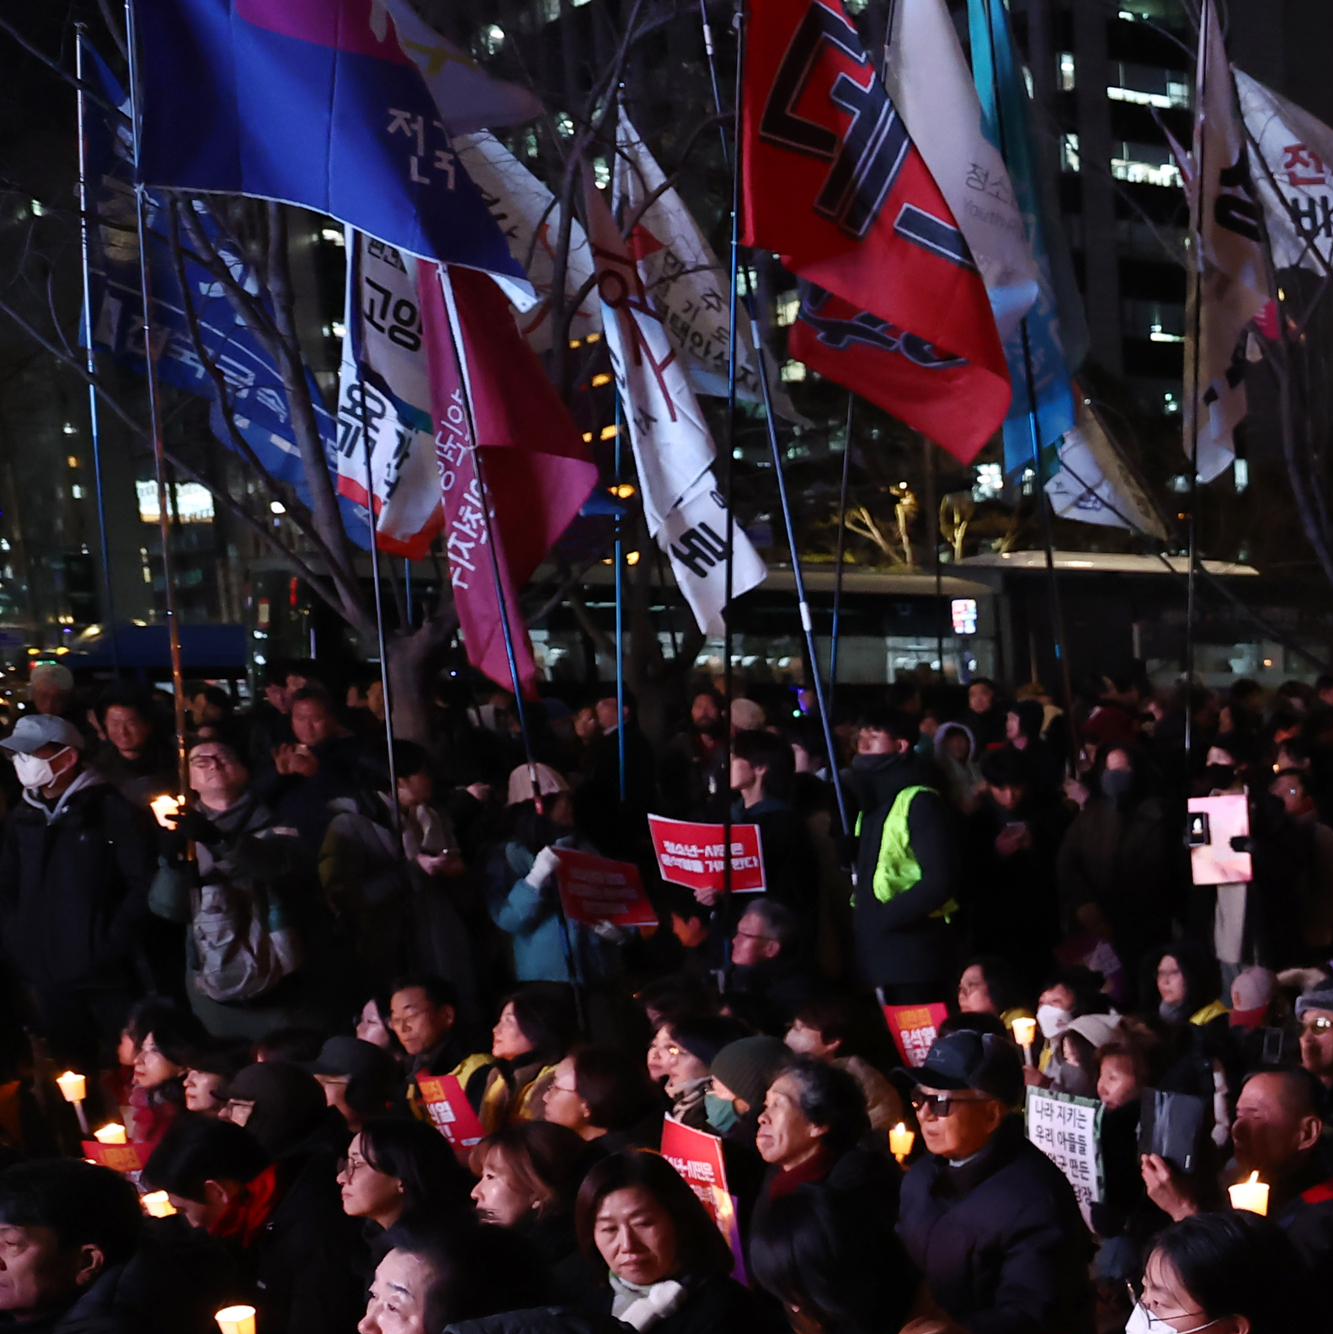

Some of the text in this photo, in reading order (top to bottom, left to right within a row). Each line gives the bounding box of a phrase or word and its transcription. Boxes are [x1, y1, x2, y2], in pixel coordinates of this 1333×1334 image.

[1035, 1101, 1088, 1130] 나라 지키는
[1035, 1125, 1088, 1156] 우리 아들들
